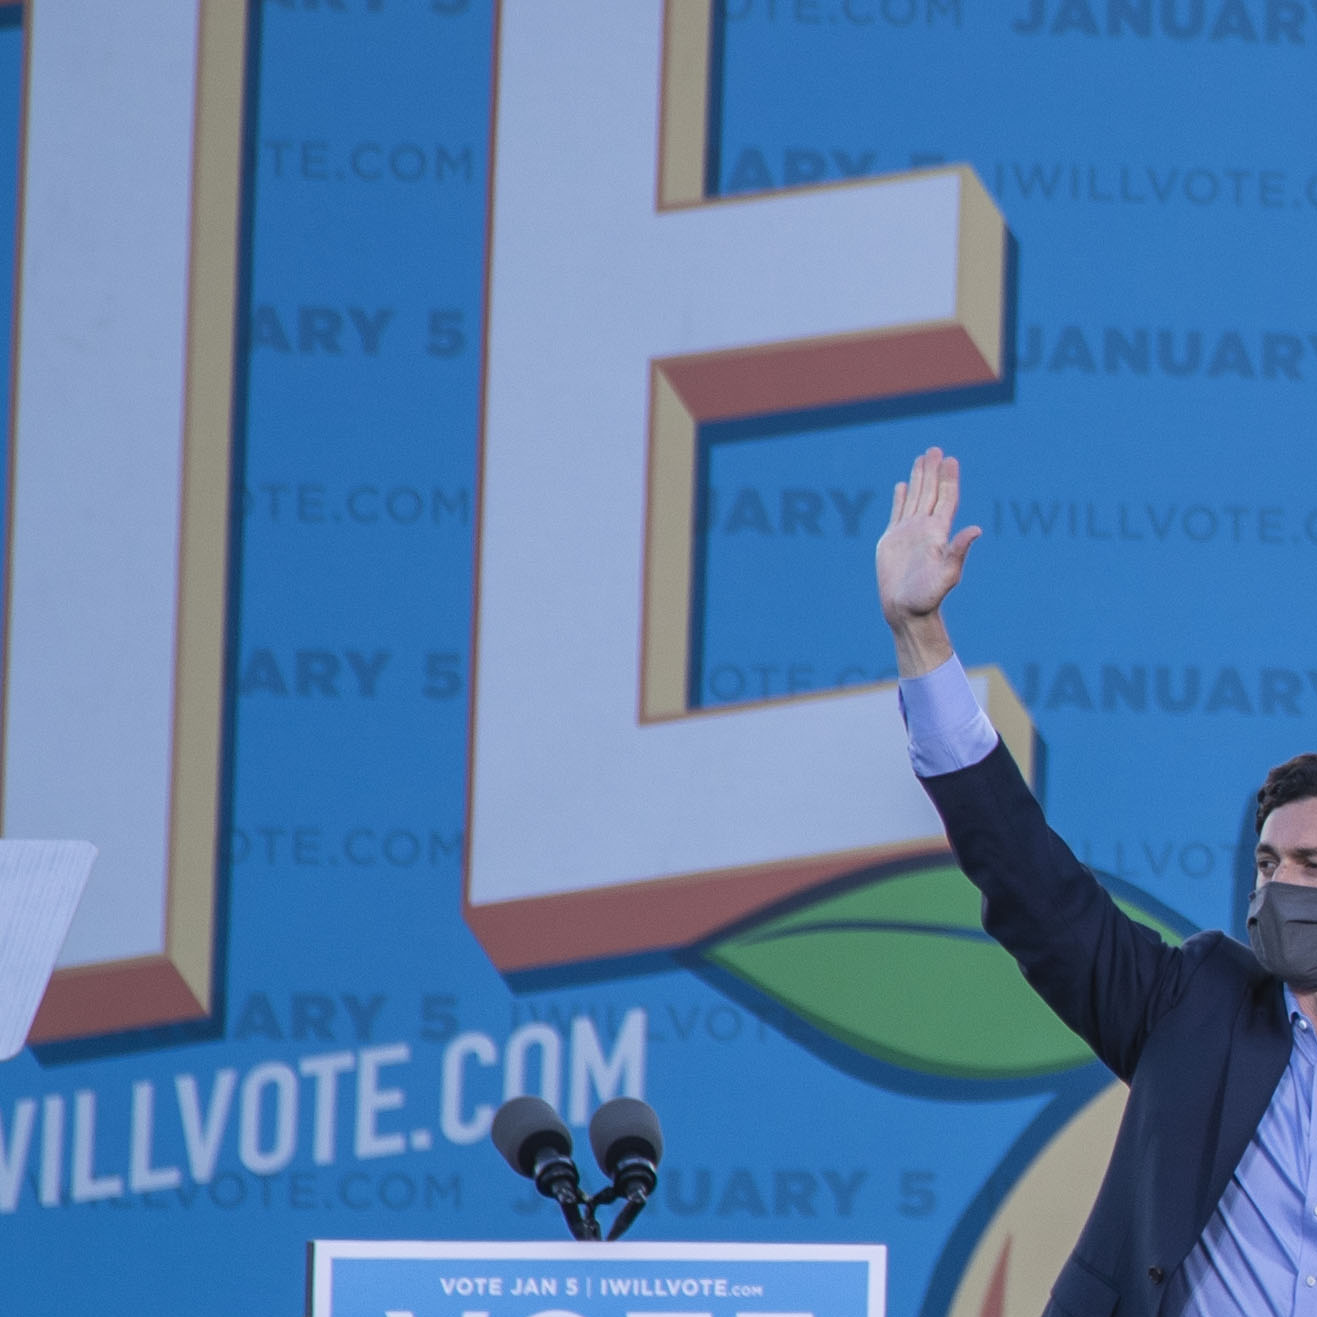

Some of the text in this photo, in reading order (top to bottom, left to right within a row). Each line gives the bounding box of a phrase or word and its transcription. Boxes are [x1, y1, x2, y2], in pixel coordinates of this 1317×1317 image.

[423, 306, 468, 361] 5
[240, 481, 470, 527] TE.COM
[420, 647, 463, 701] 5
[417, 991, 460, 1044] 5
[895, 1170, 939, 1220] 5
[439, 1277, 503, 1297] VOTE
[510, 1277, 559, 1297] JAN
[565, 1278, 579, 1297] 5
